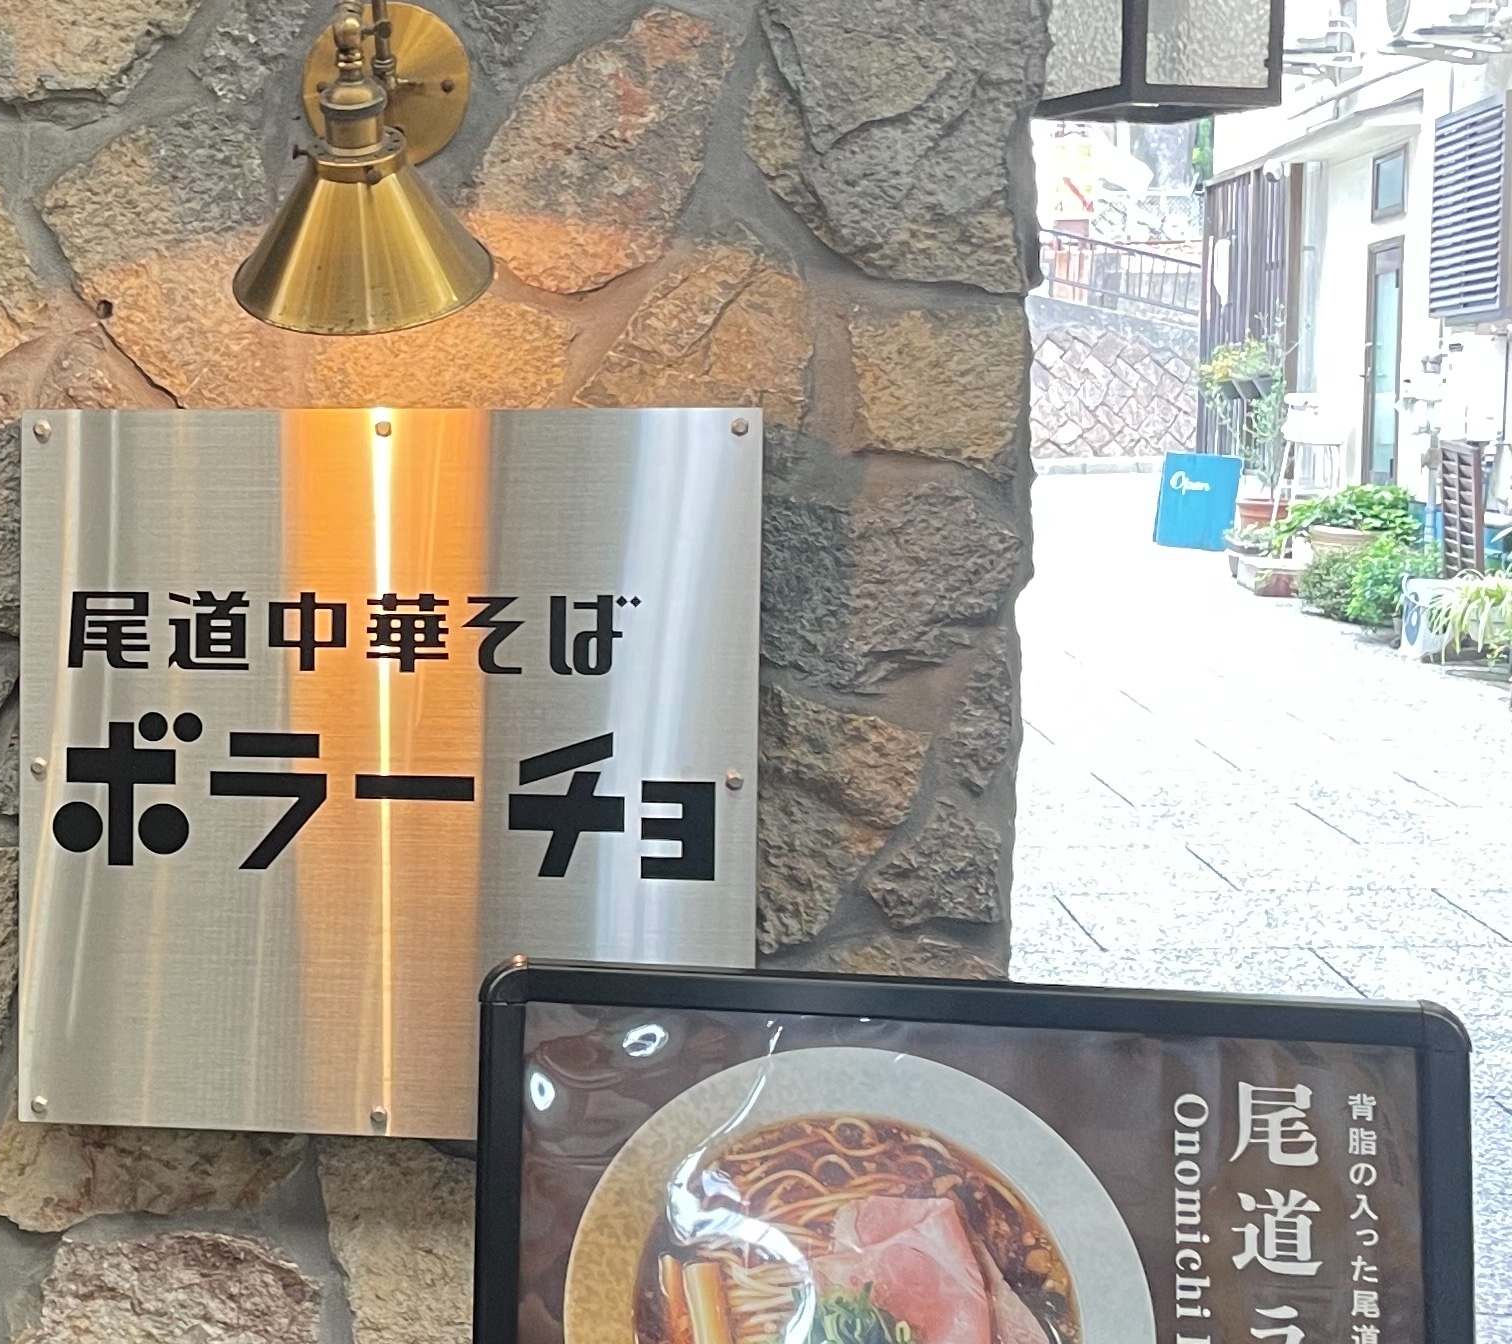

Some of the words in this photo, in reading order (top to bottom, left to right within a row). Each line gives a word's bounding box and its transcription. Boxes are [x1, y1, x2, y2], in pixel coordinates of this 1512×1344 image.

[67, 590, 642, 676] 尾道中華そば
[52, 711, 716, 881] ボラーチョ
[1173, 1093, 1211, 1319] Onomichi
